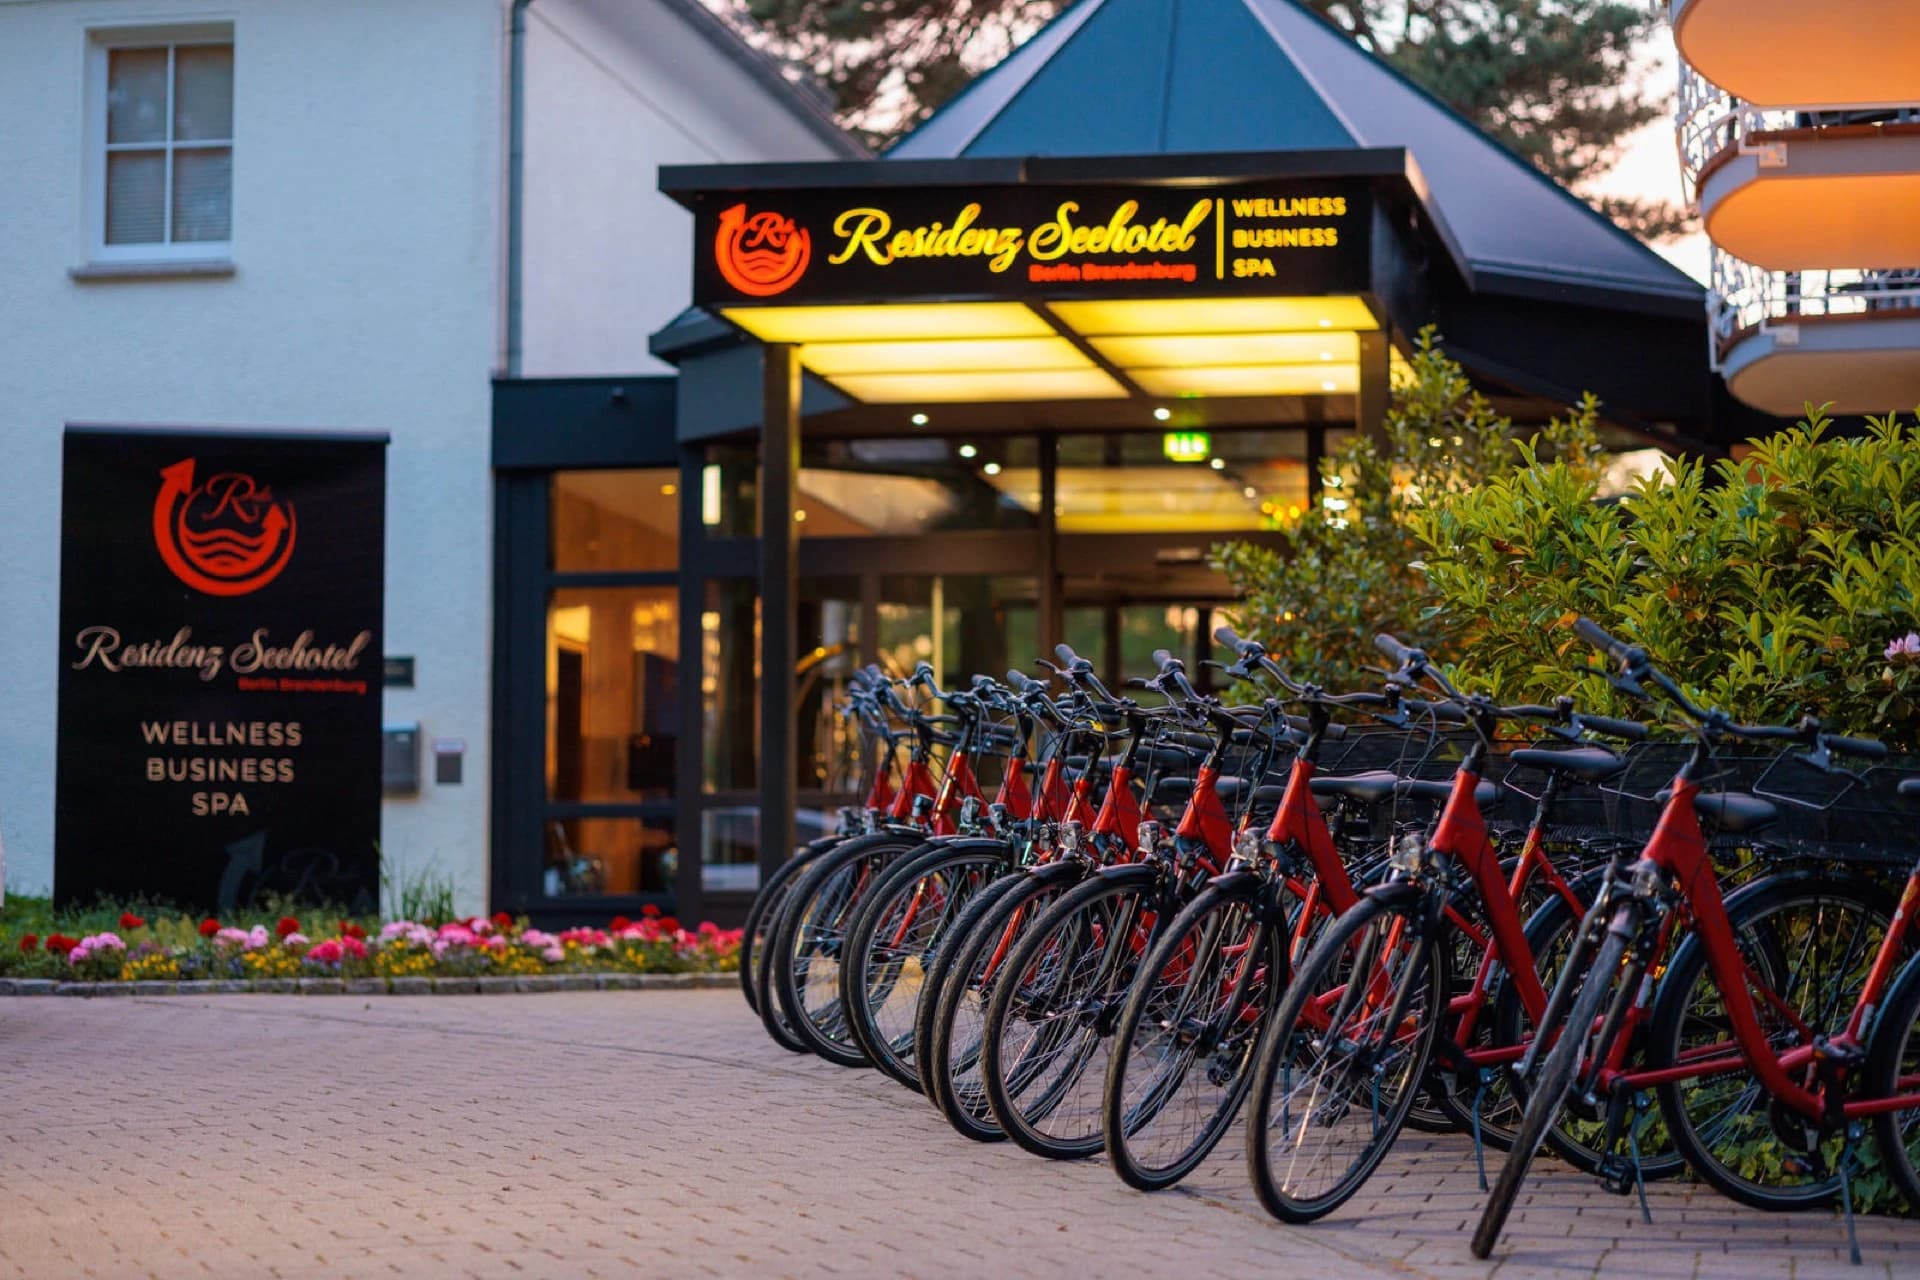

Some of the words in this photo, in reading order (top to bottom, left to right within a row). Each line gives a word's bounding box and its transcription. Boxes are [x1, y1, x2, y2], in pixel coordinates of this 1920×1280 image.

[1232, 197, 1347, 218] WELLNESS
[828, 201, 1025, 272] Residenz
[1028, 199, 1213, 261] Seehotel
[1232, 227, 1338, 248] BUSINESS
[1232, 257, 1277, 278] SPA
[72, 625, 225, 681] Residenz
[230, 627, 372, 673] Seehotel
[141, 721, 302, 746] WELLNESS
[147, 757, 295, 783] BUSINESS
[192, 792, 250, 817] SPA
